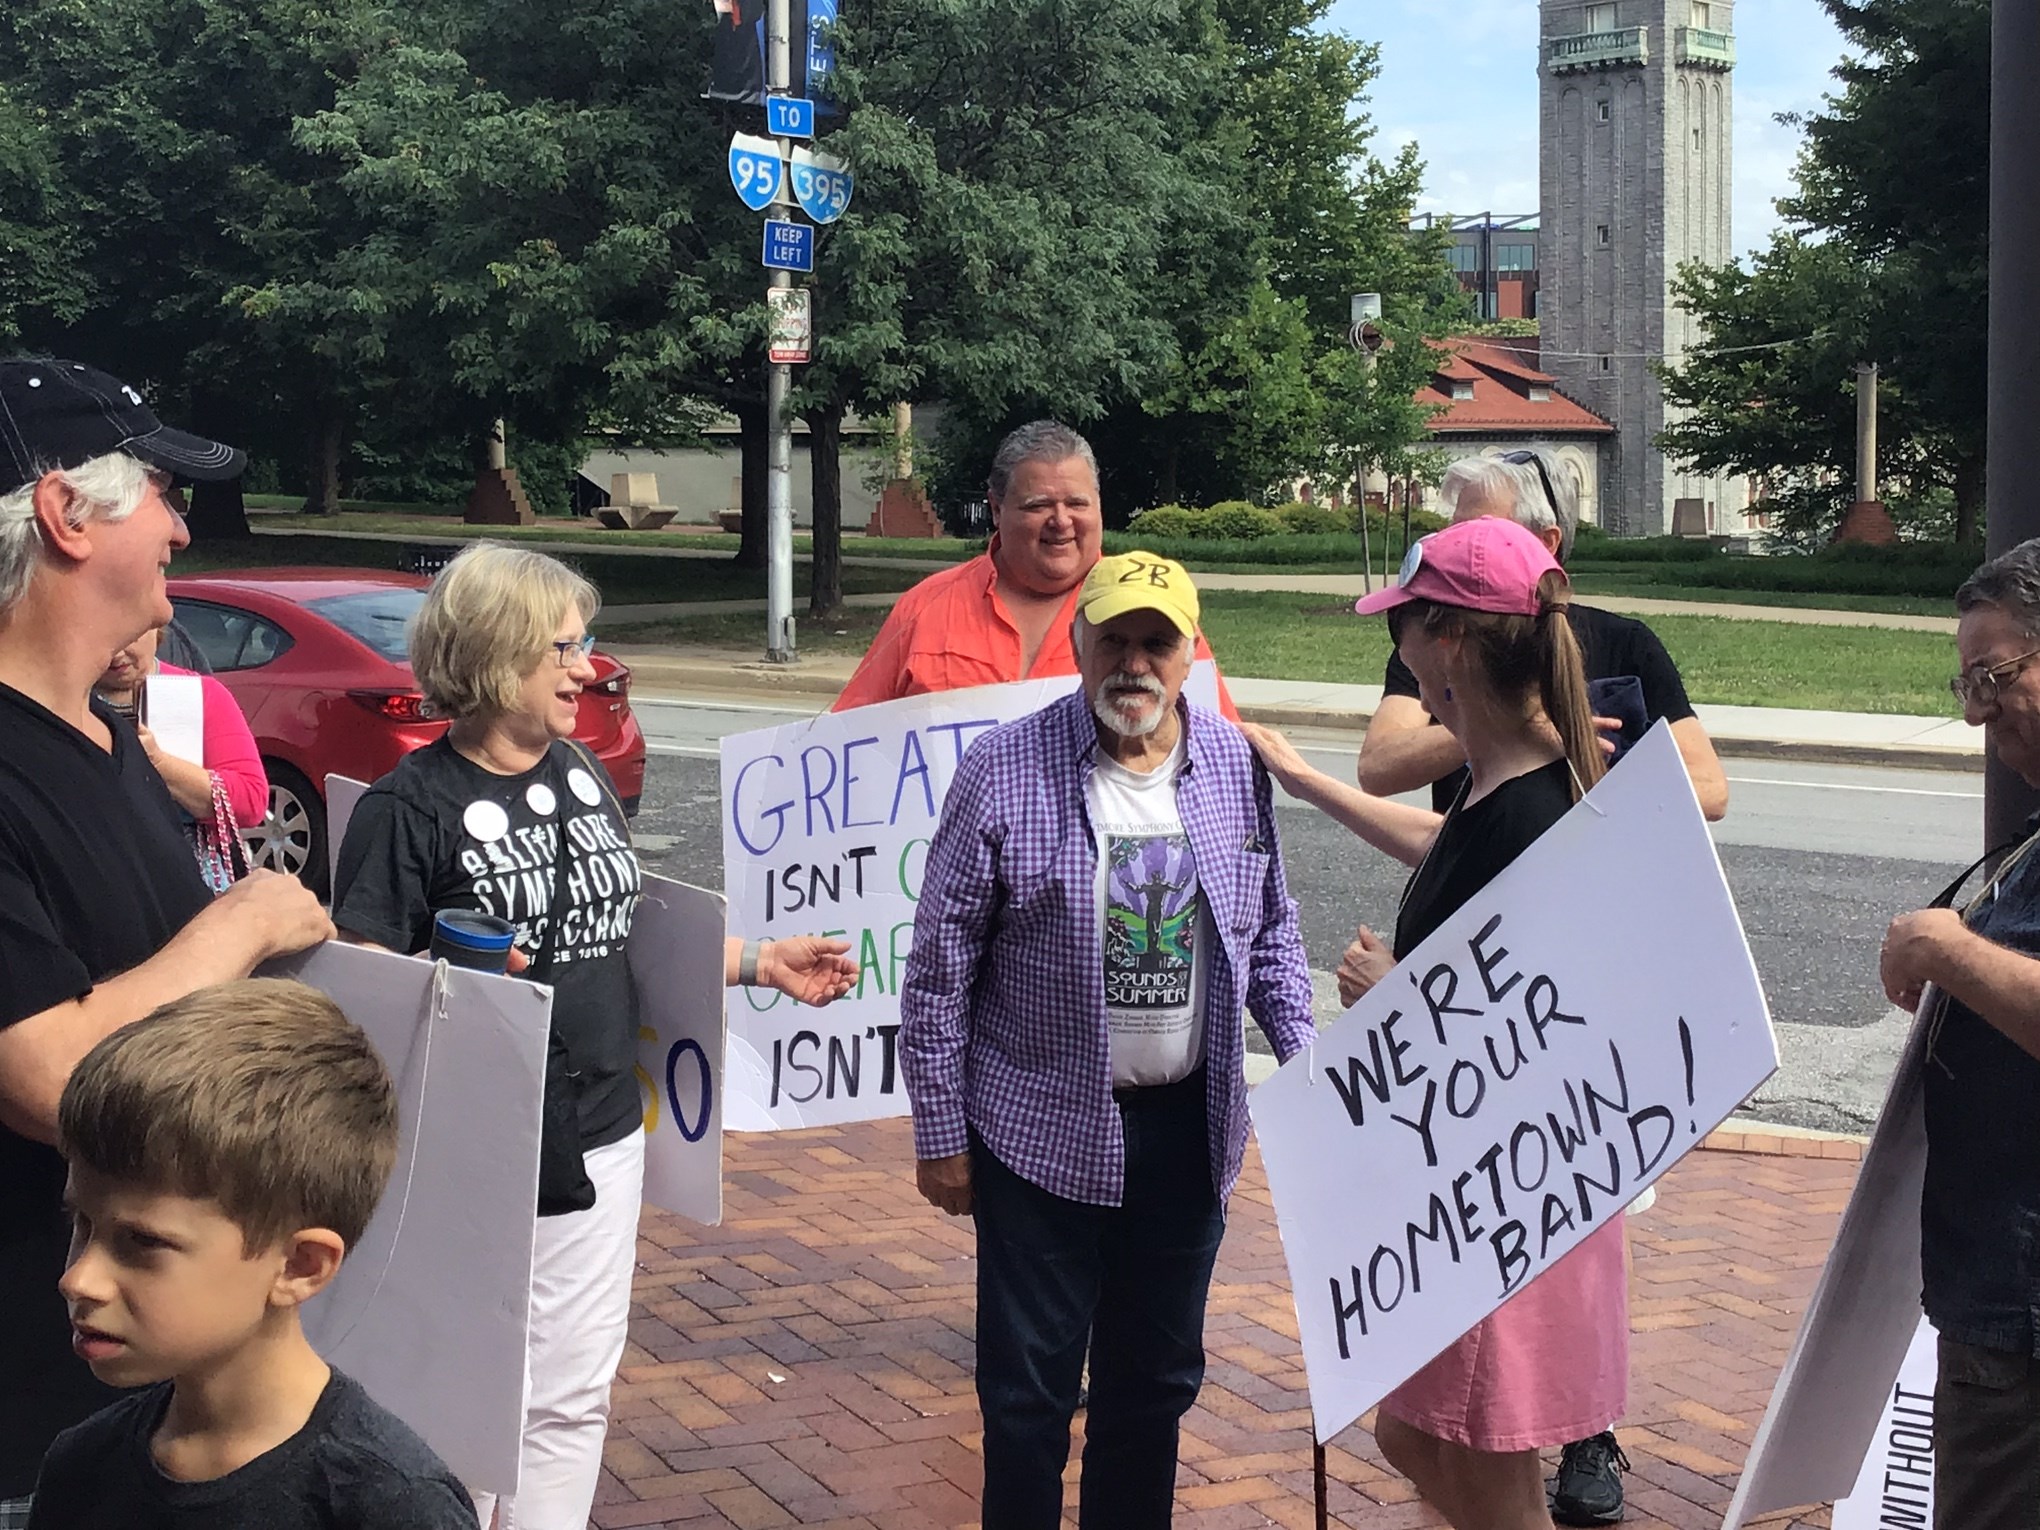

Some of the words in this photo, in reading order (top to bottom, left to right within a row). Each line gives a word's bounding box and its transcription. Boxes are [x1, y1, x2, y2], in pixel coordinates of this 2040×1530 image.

[778, 105, 801, 128] TO
[736, 156, 774, 195] 95
[798, 171, 846, 209] 395
[773, 248, 802, 263] LEFT
[774, 226, 803, 244] KEEP
[1118, 558, 1171, 589] 2B
[732, 718, 999, 857] GREAT
[765, 845, 877, 923] ISN'T
[1105, 987, 1187, 1004] SUMMER
[1107, 971, 1178, 987] SOUNDS
[1325, 913, 1524, 1126] WE'RE
[770, 1024, 901, 1109] ISN'T
[1391, 974, 1587, 1167] YOUR
[1489, 1015, 1698, 1300] BAND!
[1329, 1038, 1629, 1361] HOMETOWN
[1879, 1382, 1936, 1530] WITHOUT
